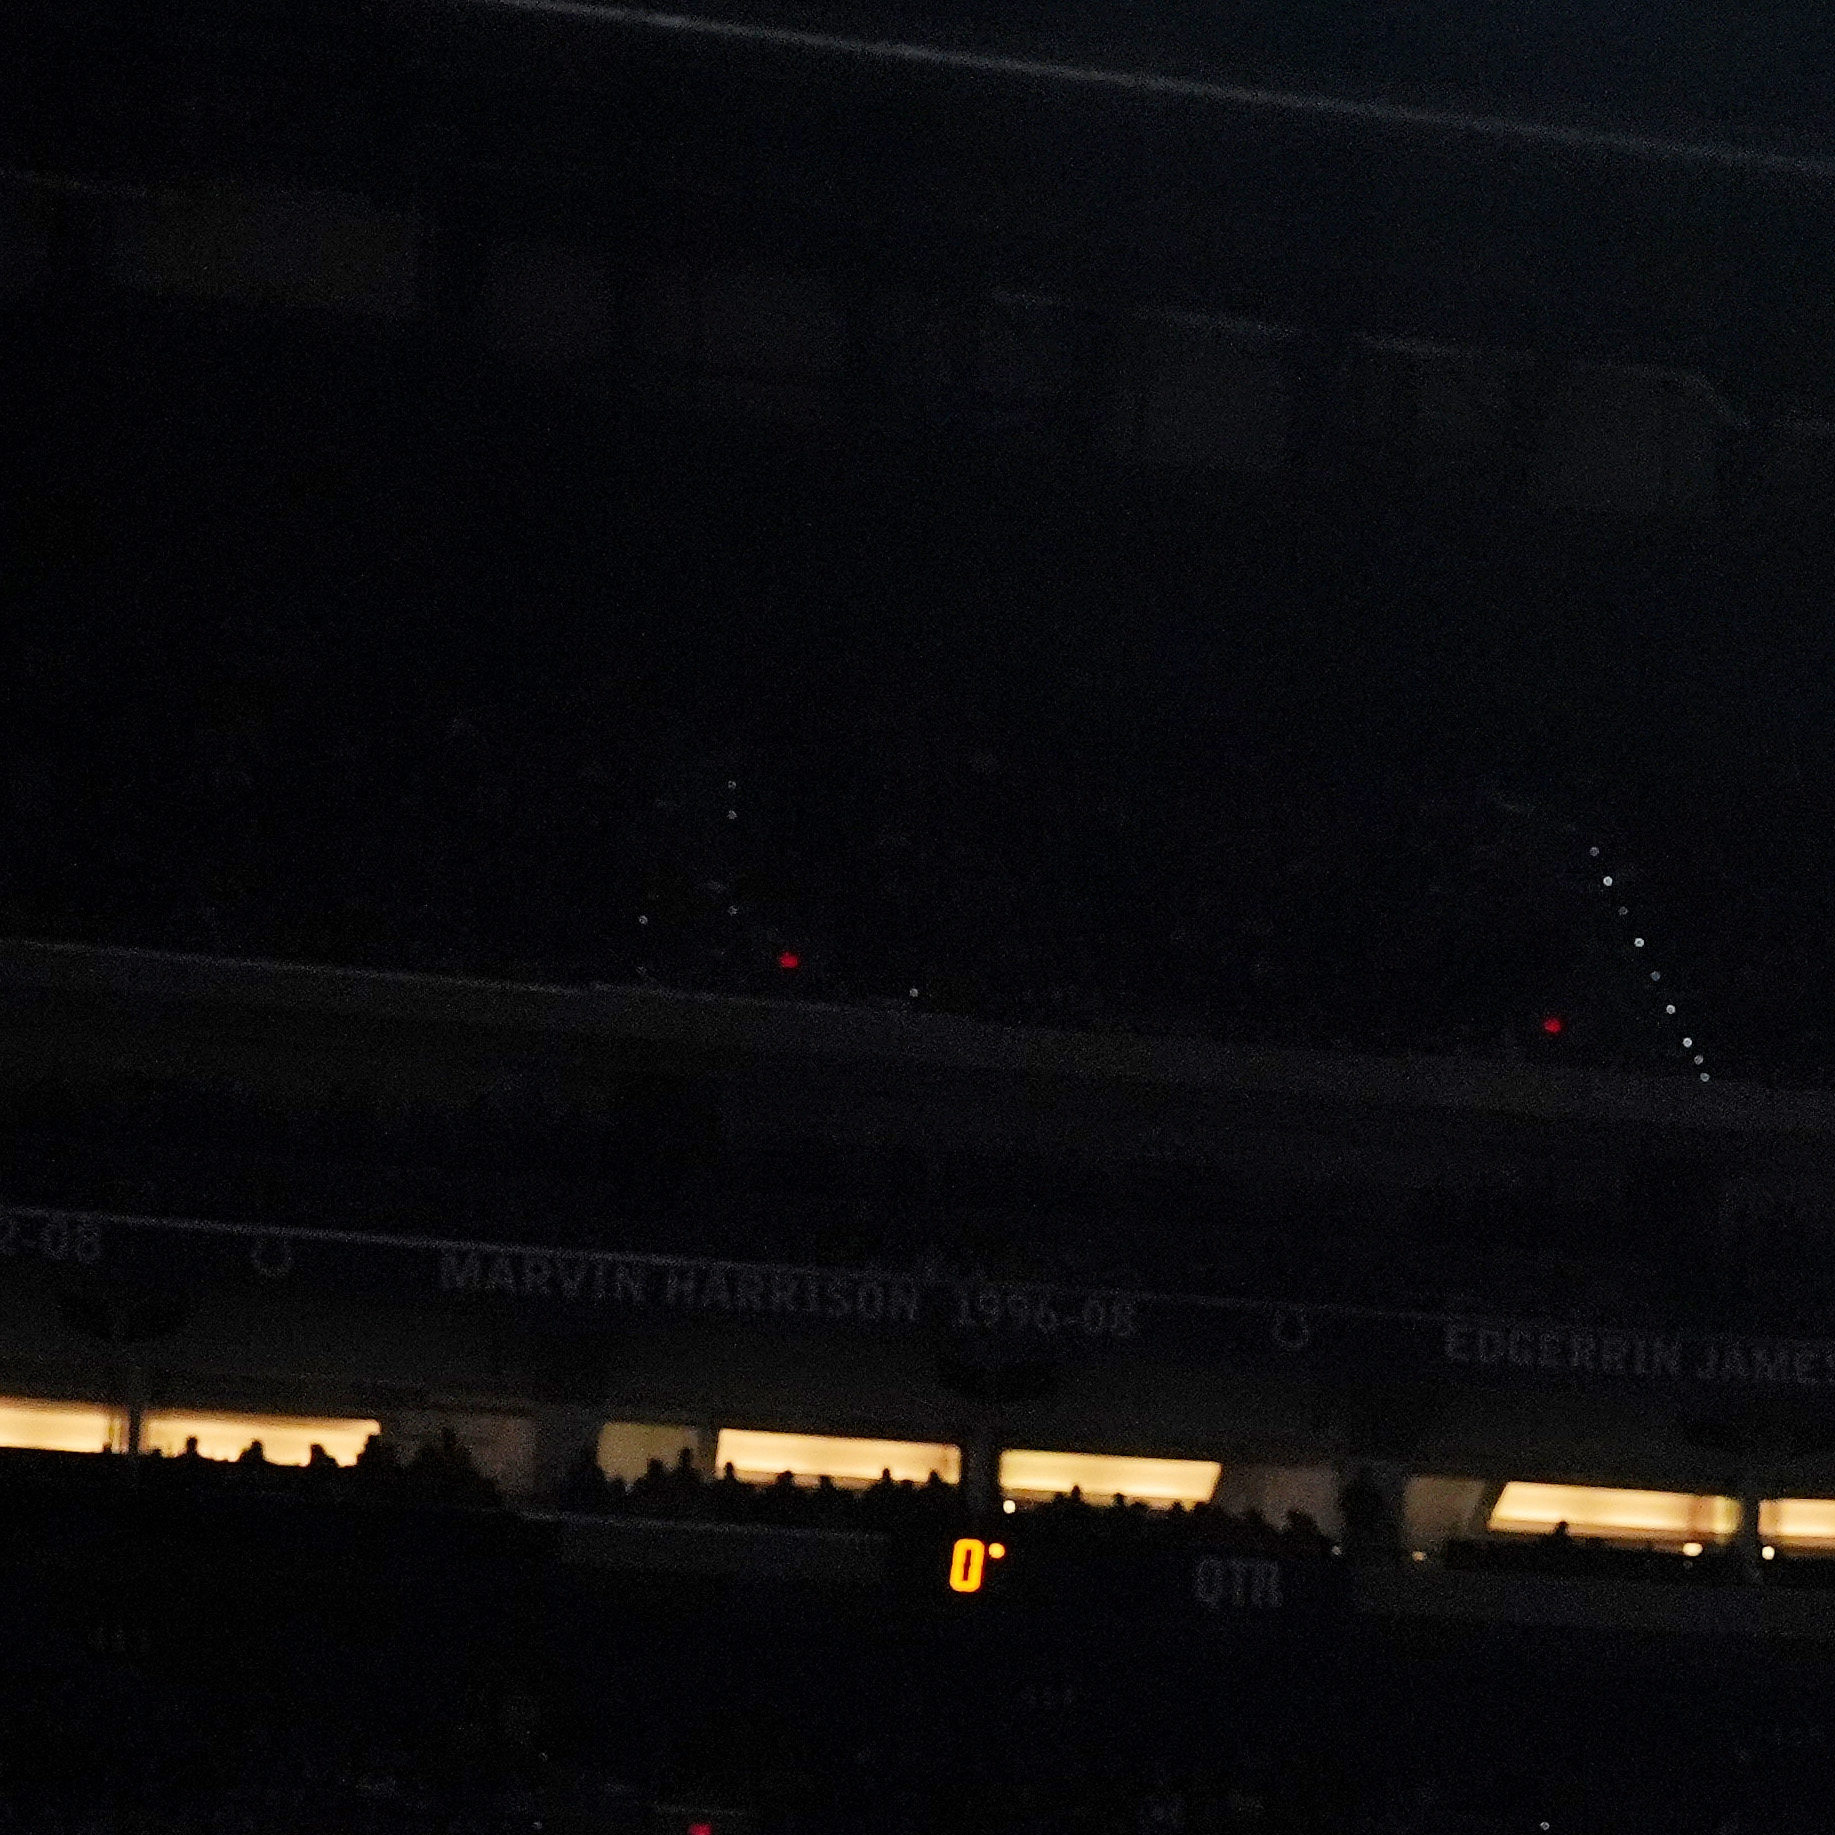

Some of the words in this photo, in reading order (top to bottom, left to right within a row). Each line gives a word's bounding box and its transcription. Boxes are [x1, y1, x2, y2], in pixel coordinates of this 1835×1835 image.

[439, 1248, 647, 1308] MARVIN
[661, 1263, 919, 1324] HARRISON
[1444, 1323, 1683, 1378] EDGERRIN
